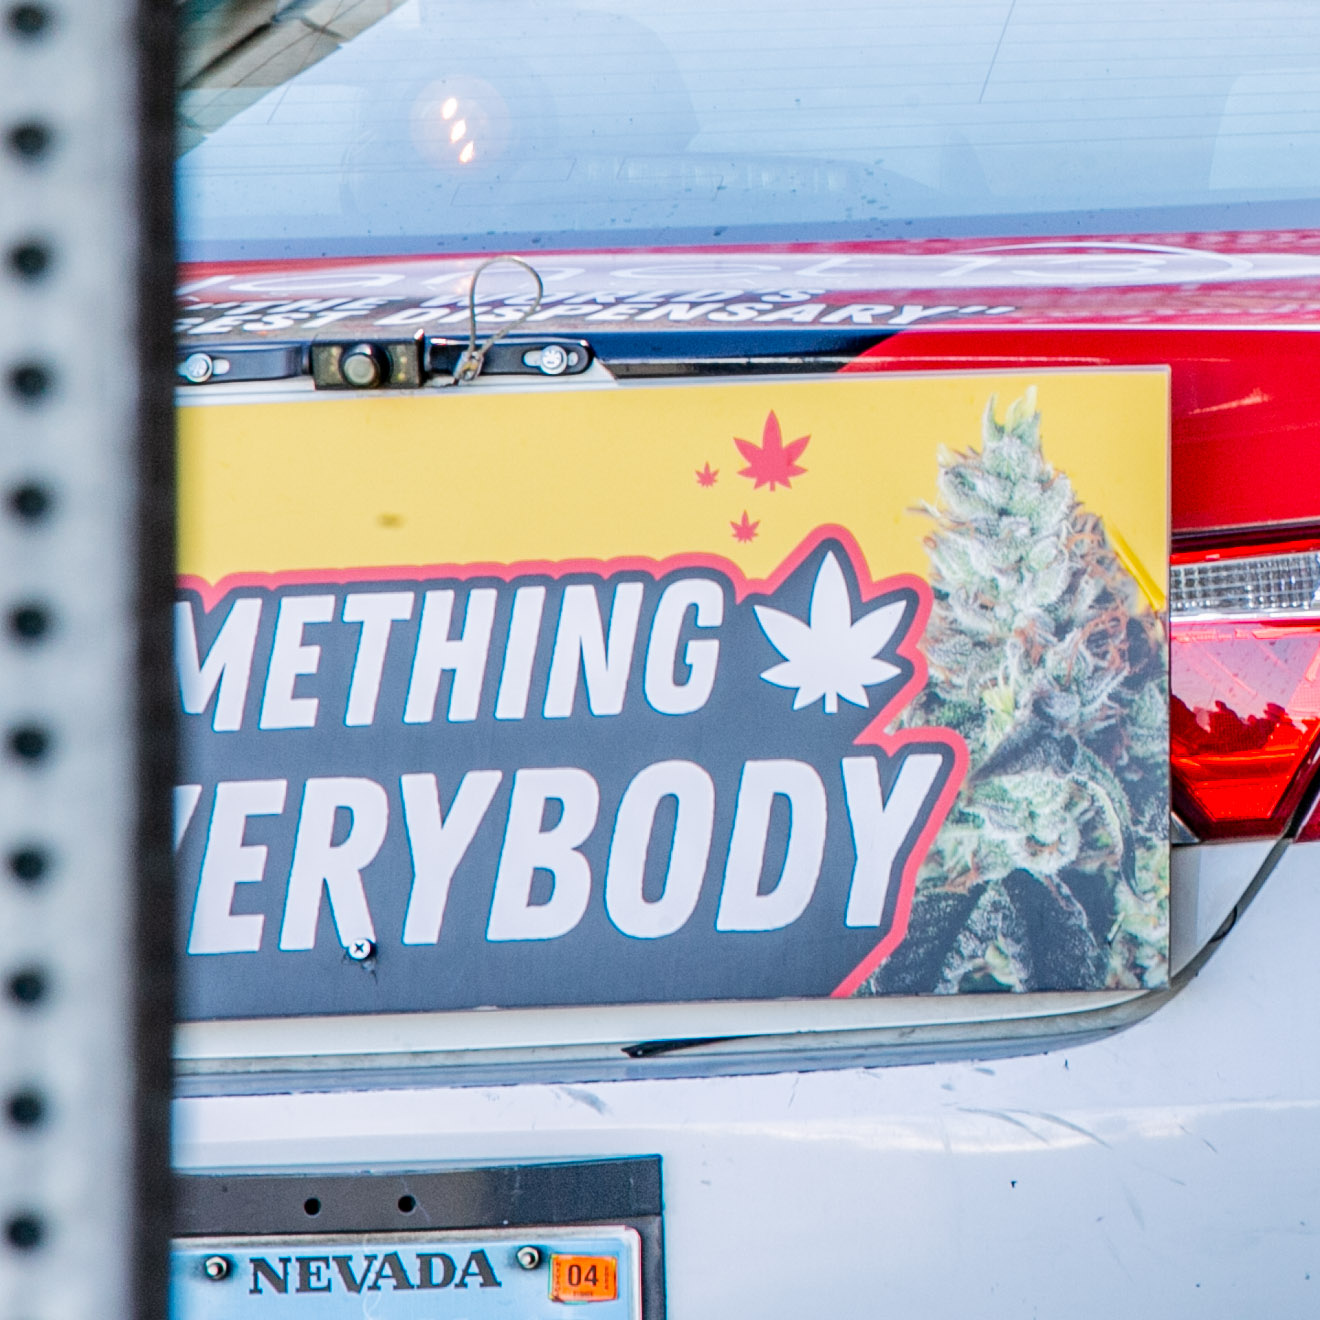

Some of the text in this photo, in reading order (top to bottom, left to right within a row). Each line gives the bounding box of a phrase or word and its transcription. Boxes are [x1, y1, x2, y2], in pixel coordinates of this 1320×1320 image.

[174, 577, 724, 732] METHING
[249, 1250, 502, 1294] NEVADA
[568, 1264, 599, 1288] 04
